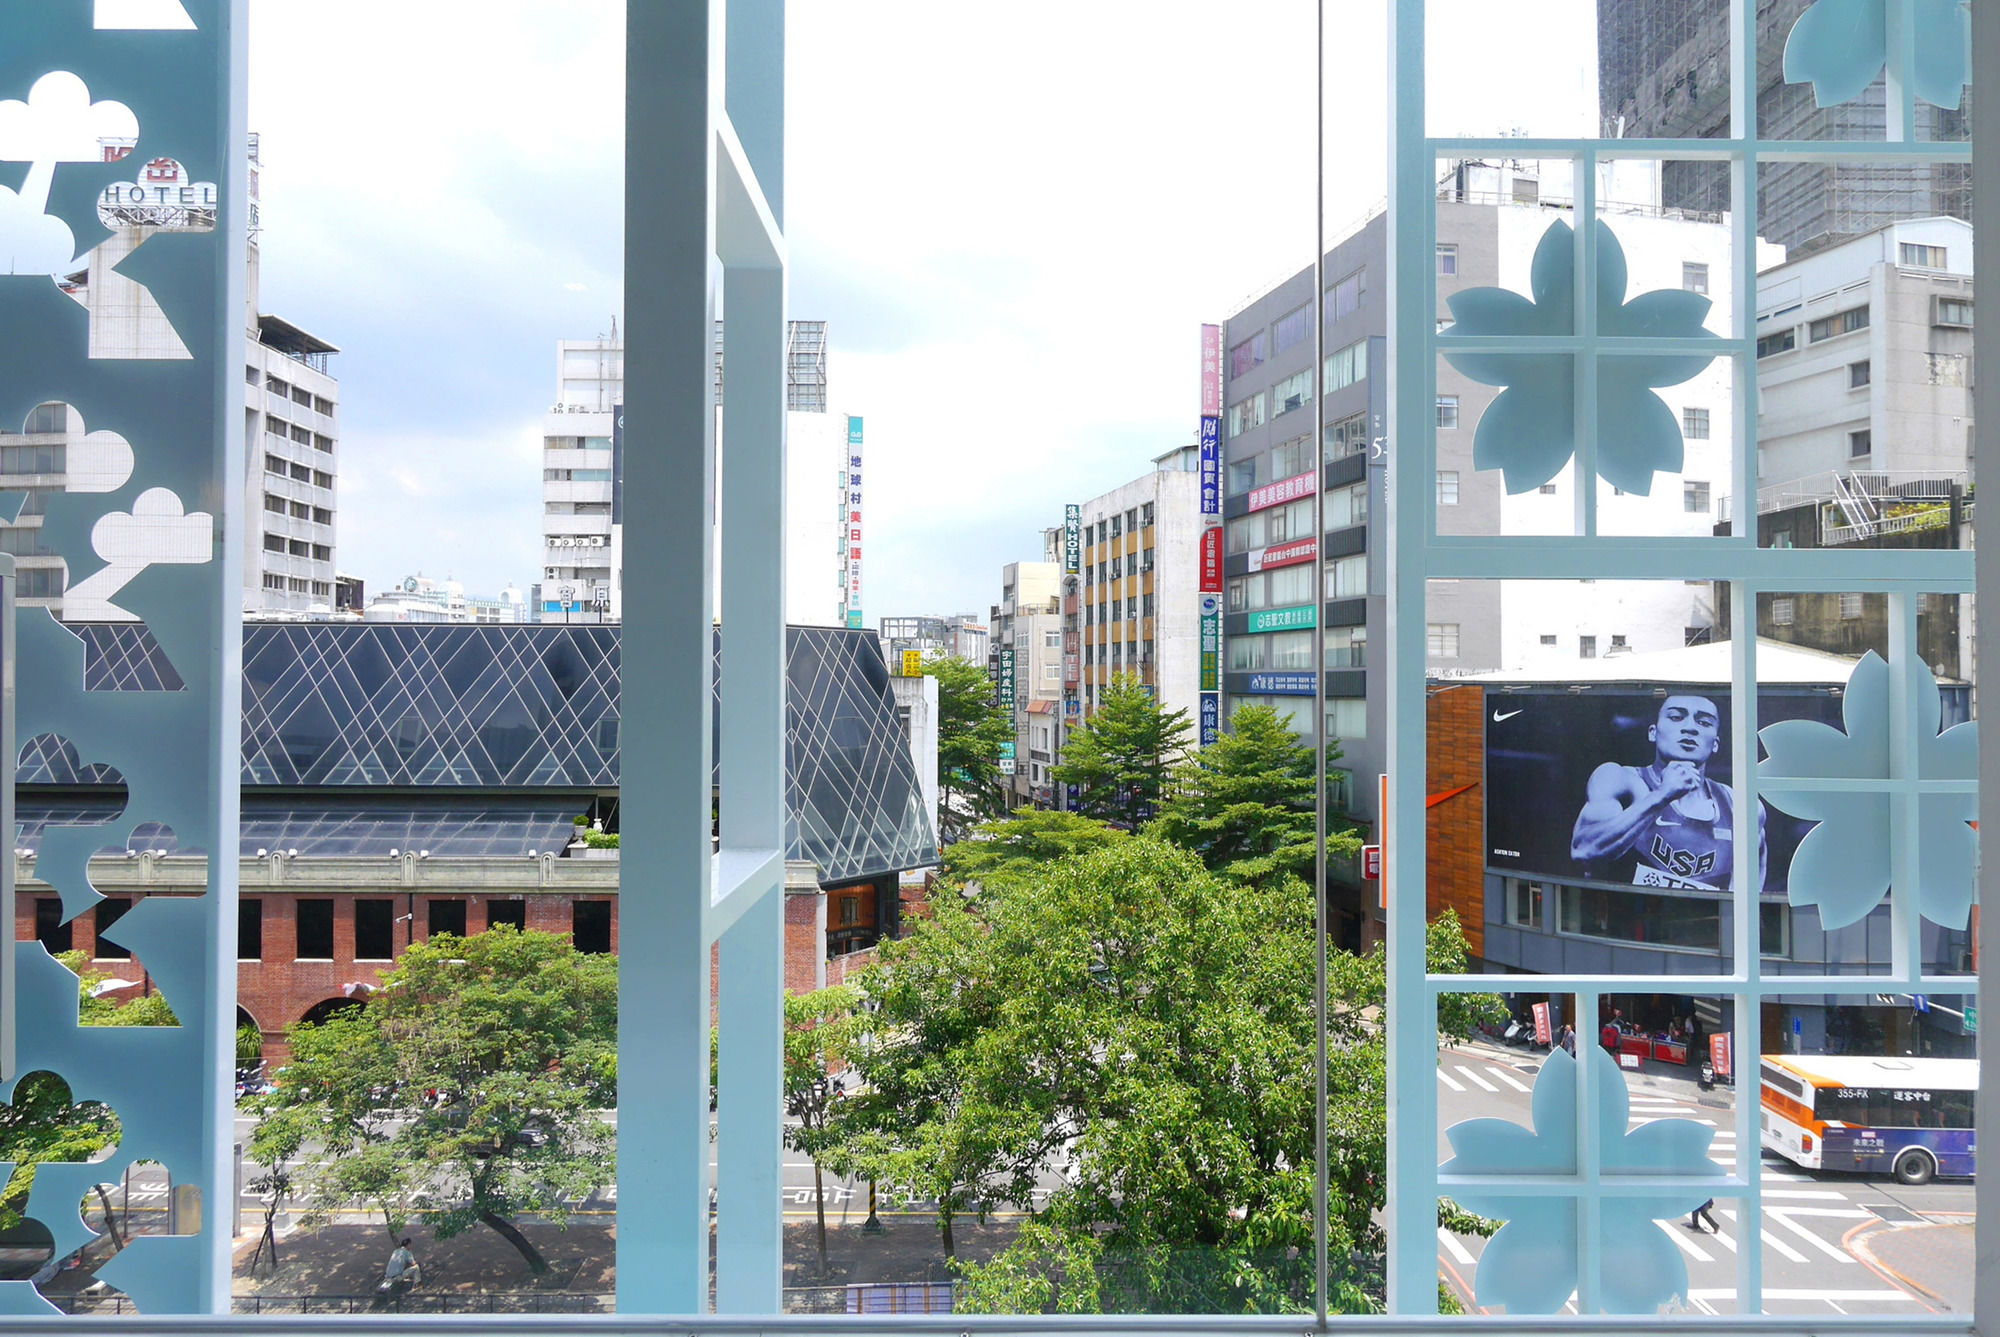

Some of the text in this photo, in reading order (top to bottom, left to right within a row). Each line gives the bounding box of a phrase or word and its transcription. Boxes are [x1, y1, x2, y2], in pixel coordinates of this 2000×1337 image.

[105, 186, 216, 204] HOTEL
[1067, 533, 1079, 569] HOTEL
[1650, 833, 1716, 878] USA
[1837, 1089, 1869, 1099] 355-FX
